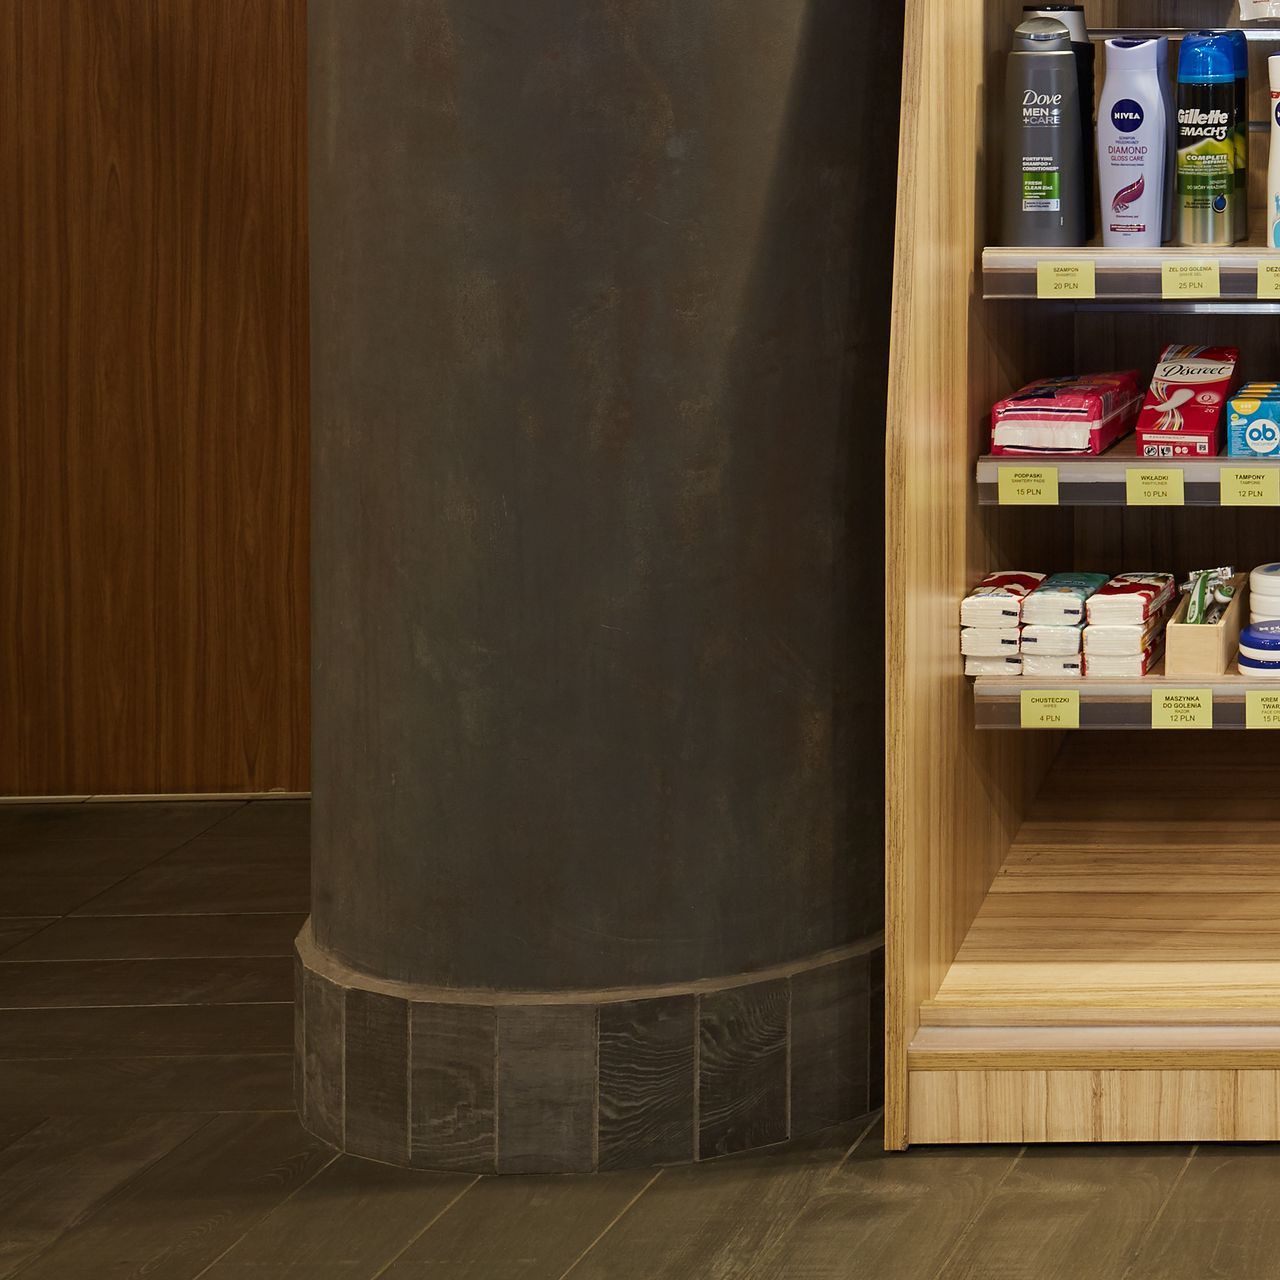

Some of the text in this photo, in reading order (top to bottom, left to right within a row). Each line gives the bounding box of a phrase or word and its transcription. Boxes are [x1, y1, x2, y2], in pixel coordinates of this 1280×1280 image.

[1022, 90, 1062, 105] Dove
[1023, 108, 1049, 116] MEN
[1178, 108, 1228, 125] Gillette
[1181, 127, 1227, 140] MACH3
[1108, 146, 1147, 154] DIAMOND
[1161, 364, 1230, 377] Discreet
[1249, 424, 1277, 441] o.b.
